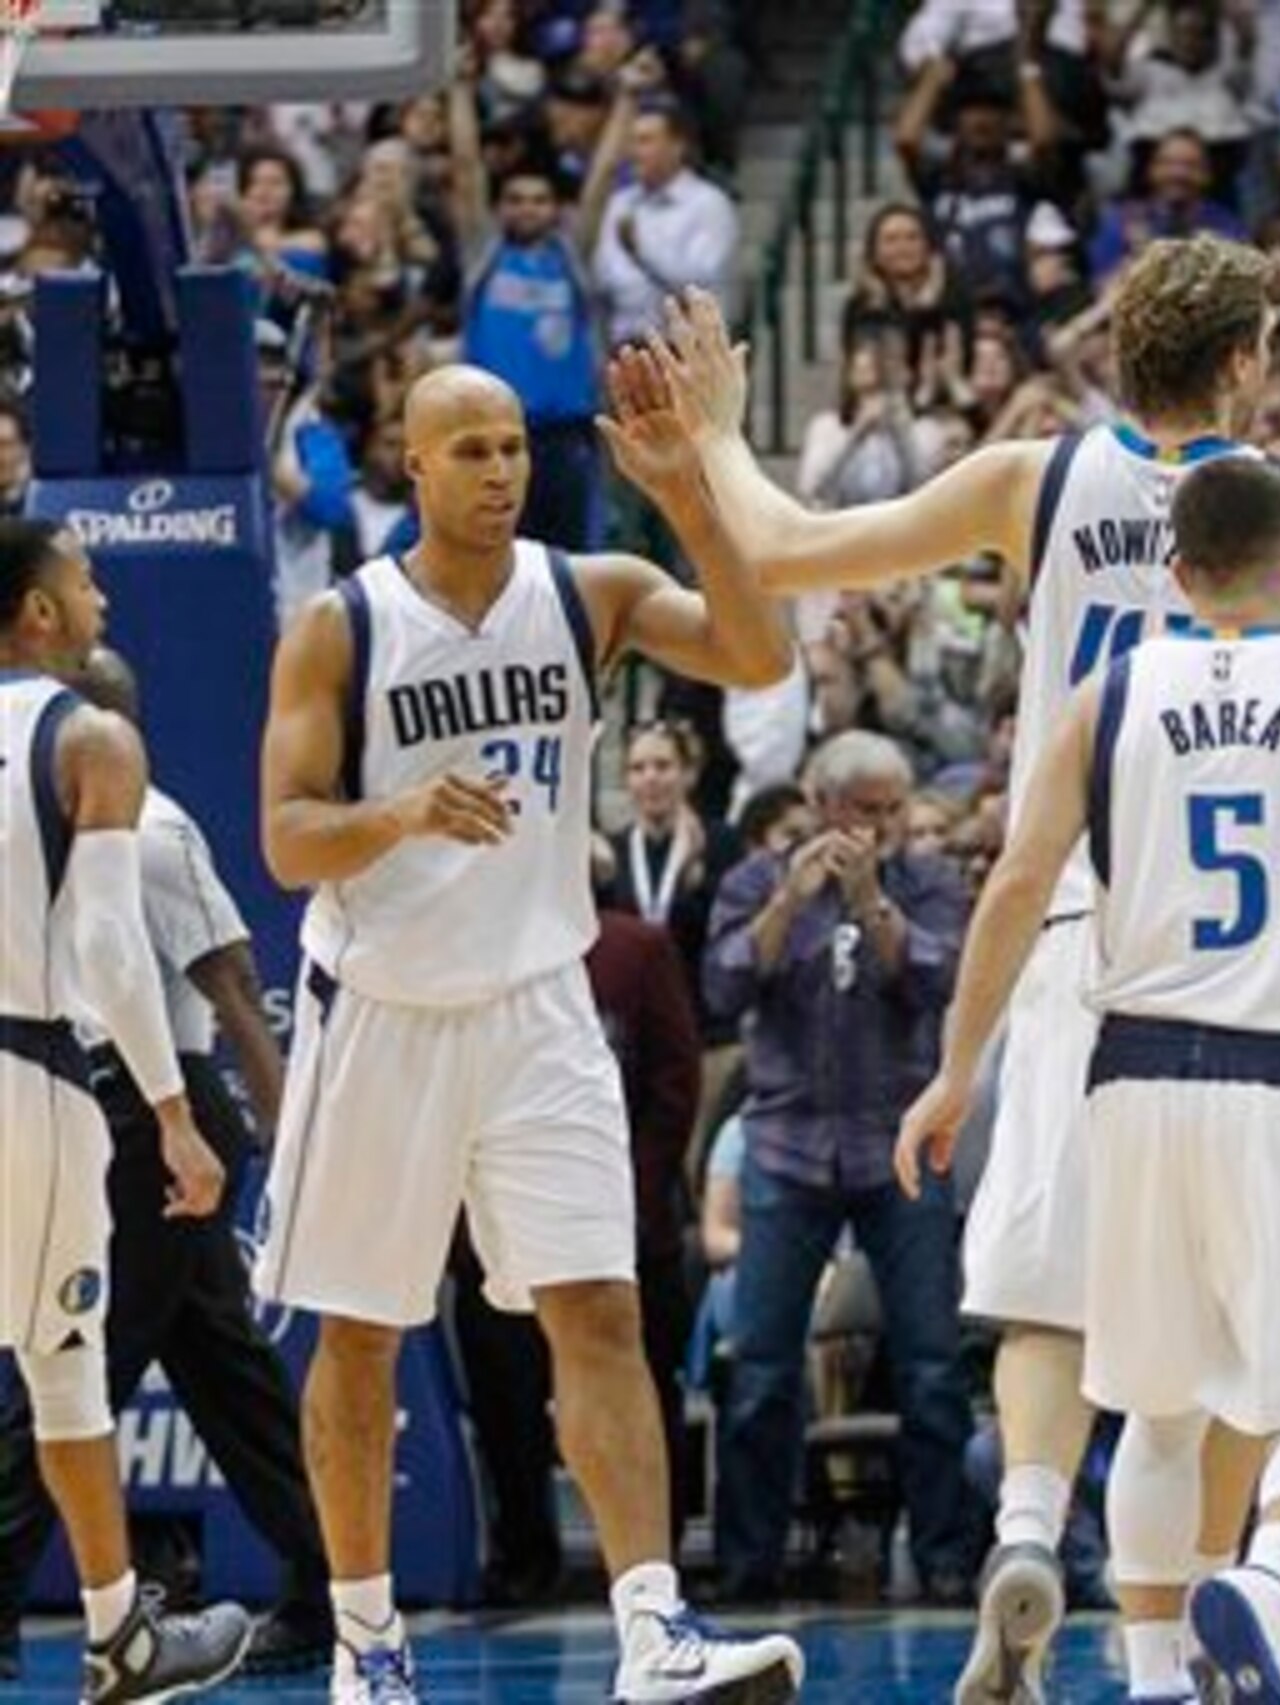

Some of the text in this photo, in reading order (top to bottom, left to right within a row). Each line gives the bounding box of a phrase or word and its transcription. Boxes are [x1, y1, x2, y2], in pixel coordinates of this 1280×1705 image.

[67, 503, 241, 546] SPALDING
[387, 664, 567, 749] DALLAS
[479, 735, 562, 819] 24
[1187, 793, 1269, 951] 5
